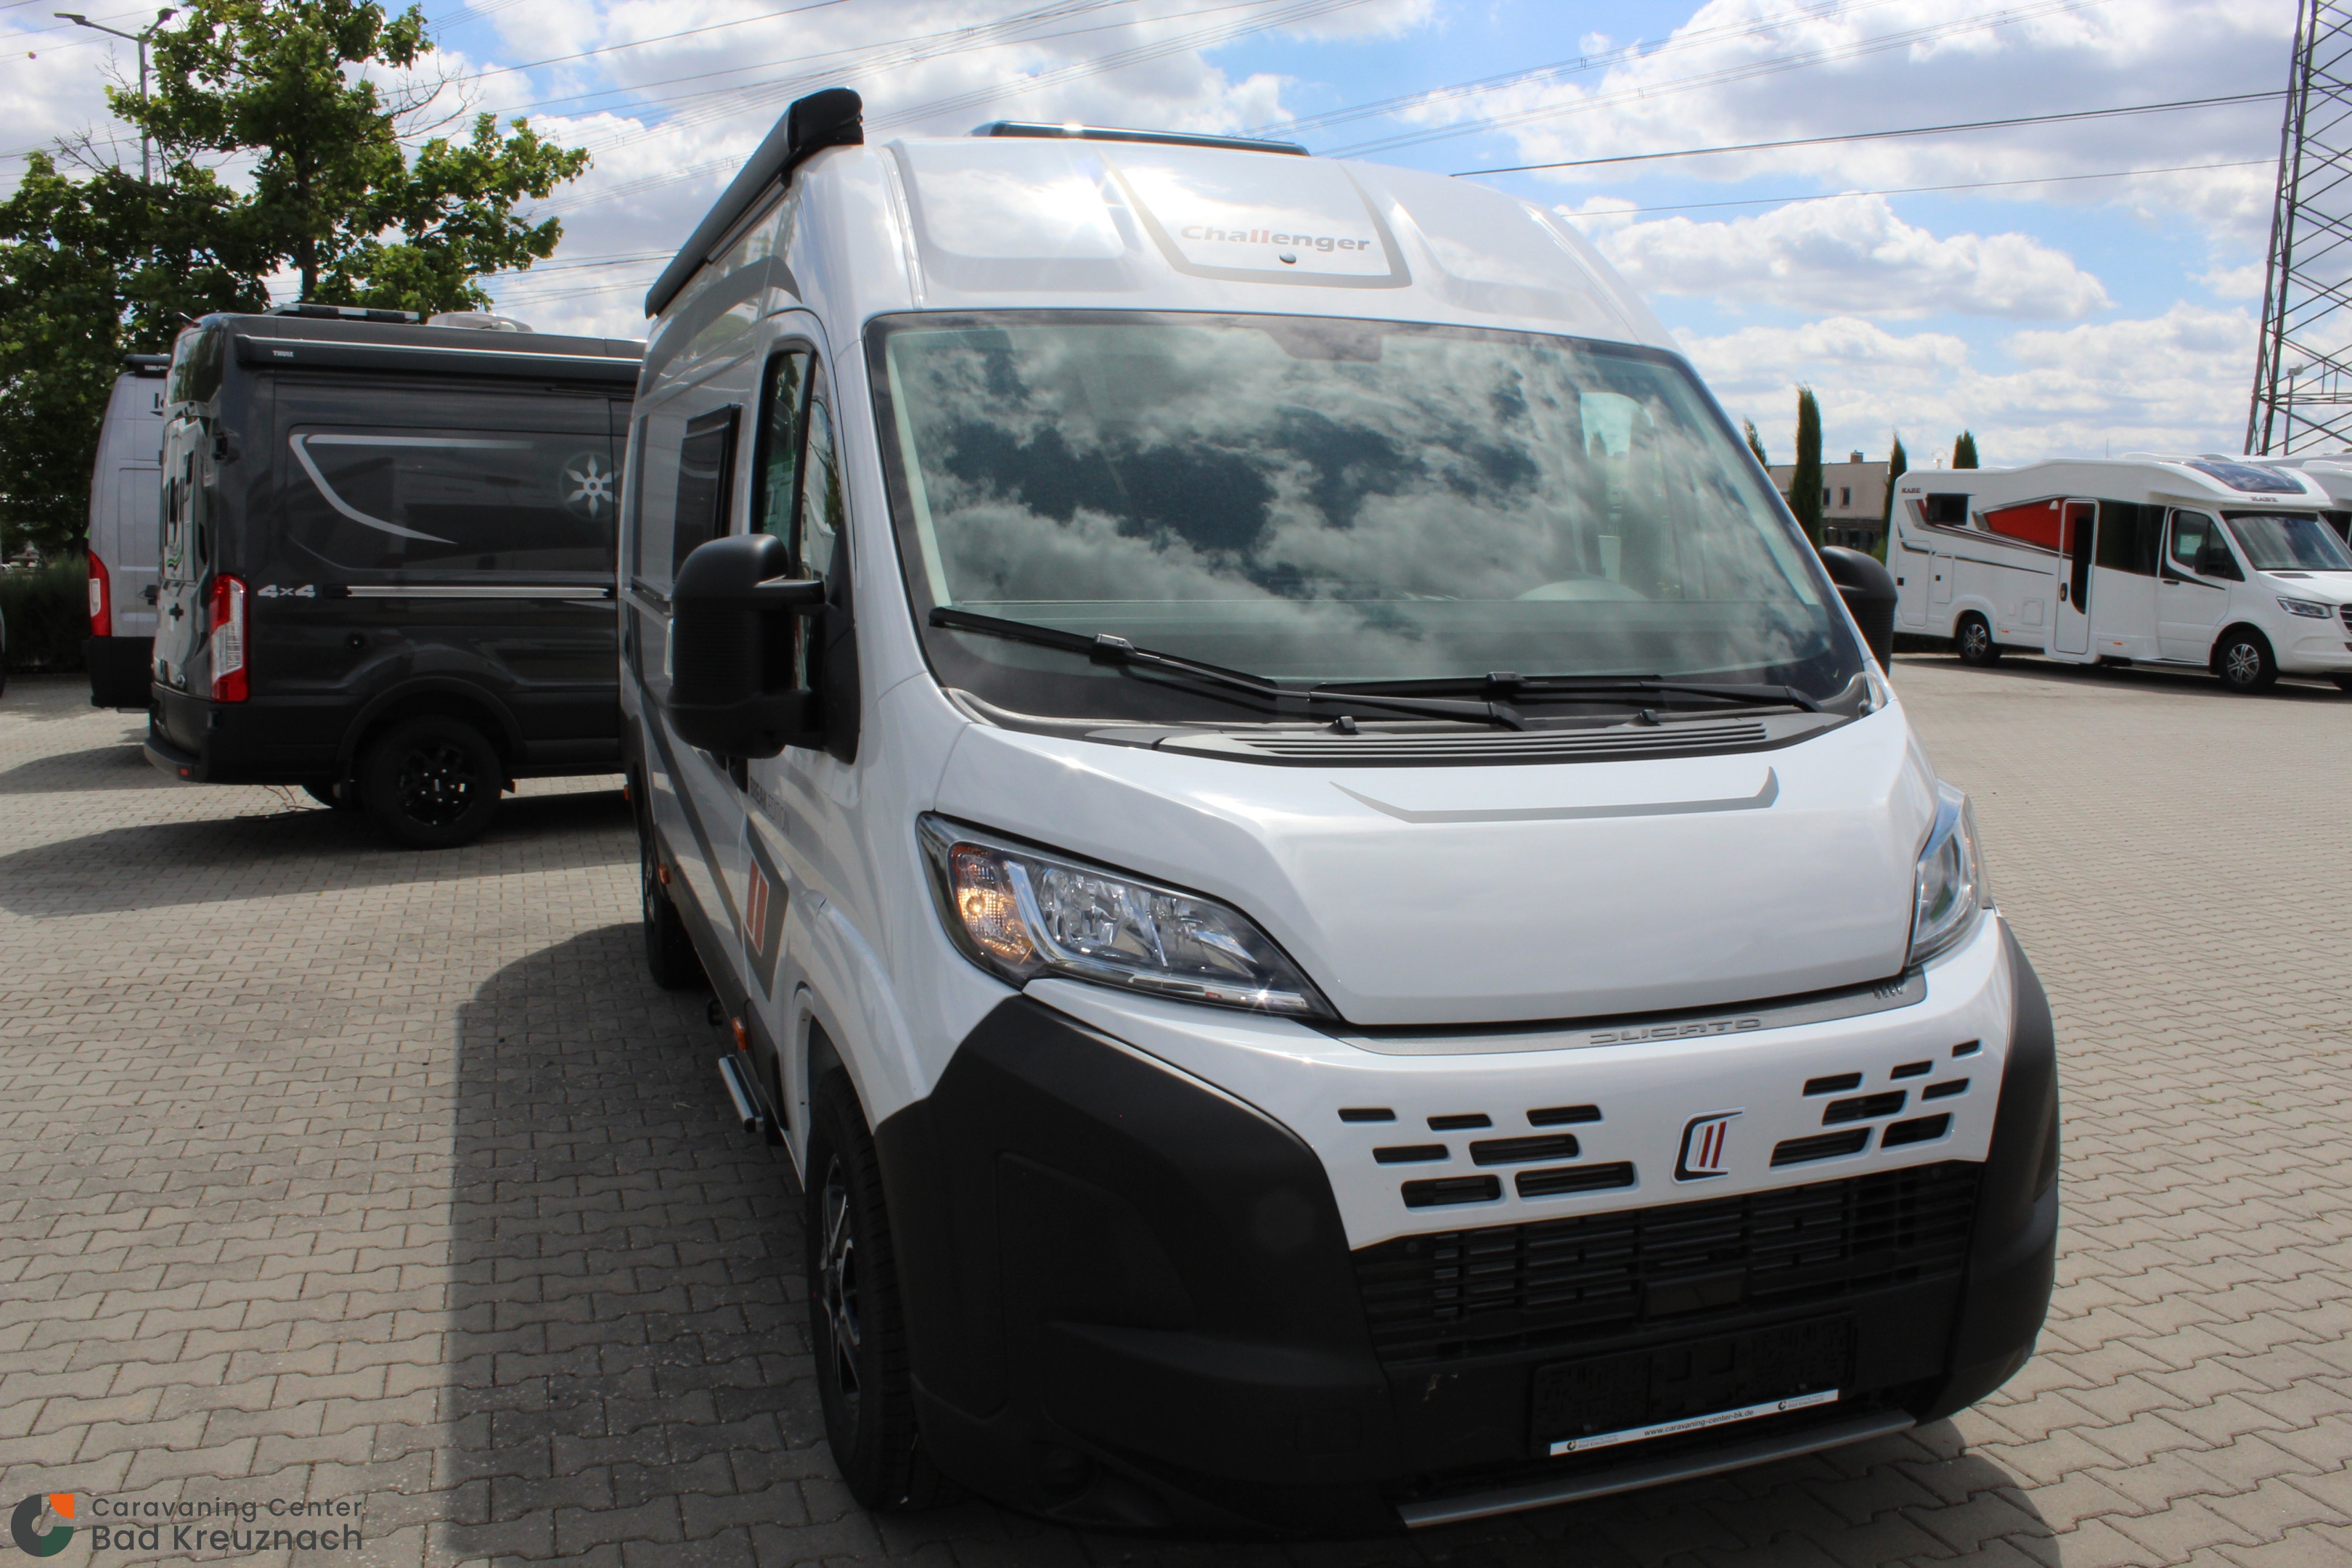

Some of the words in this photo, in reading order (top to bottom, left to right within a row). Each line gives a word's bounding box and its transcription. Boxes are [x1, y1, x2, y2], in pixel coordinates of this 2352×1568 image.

[1180, 225, 1371, 252] Challenger
[257, 584, 316, 598] 4x4
[1590, 1017, 1762, 1045] DUCATO
[1643, 1409, 1754, 1437] www.caravaning-center-bk.de
